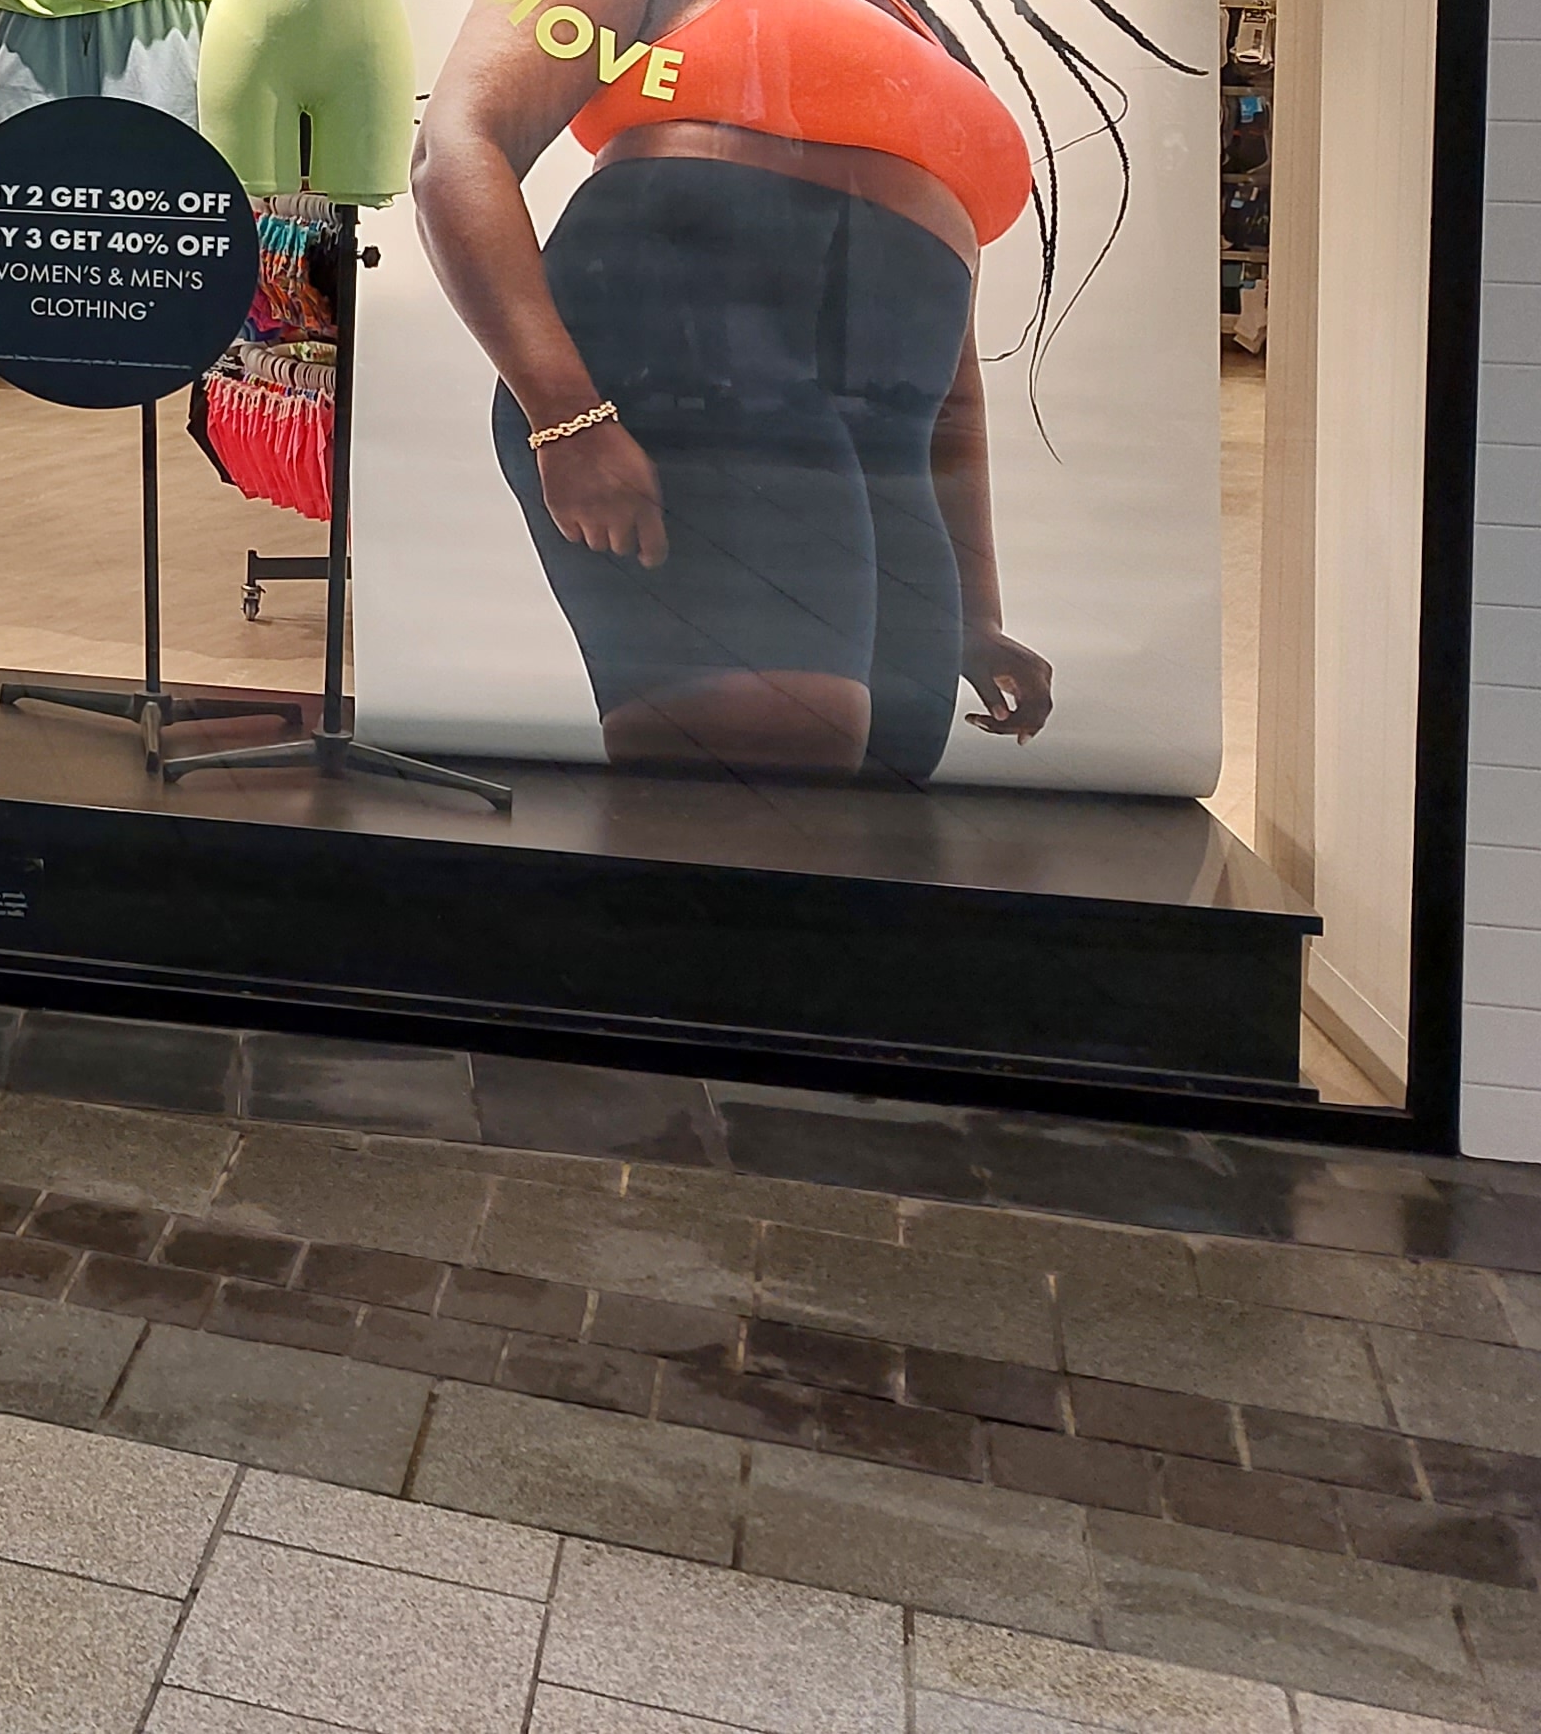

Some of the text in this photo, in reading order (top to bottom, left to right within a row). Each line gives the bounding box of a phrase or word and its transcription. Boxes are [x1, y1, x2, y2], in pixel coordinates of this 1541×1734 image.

[26, 186, 43, 206] 2
[51, 187, 103, 209] GET
[109, 189, 170, 212] 30%
[177, 192, 231, 214] OFF
[25, 228, 41, 249] 3
[50, 229, 102, 251] GET
[107, 232, 169, 255] 40%
[176, 235, 230, 257] OFF
[108, 268, 124, 286] &
[130, 269, 203, 290] MEN'S
